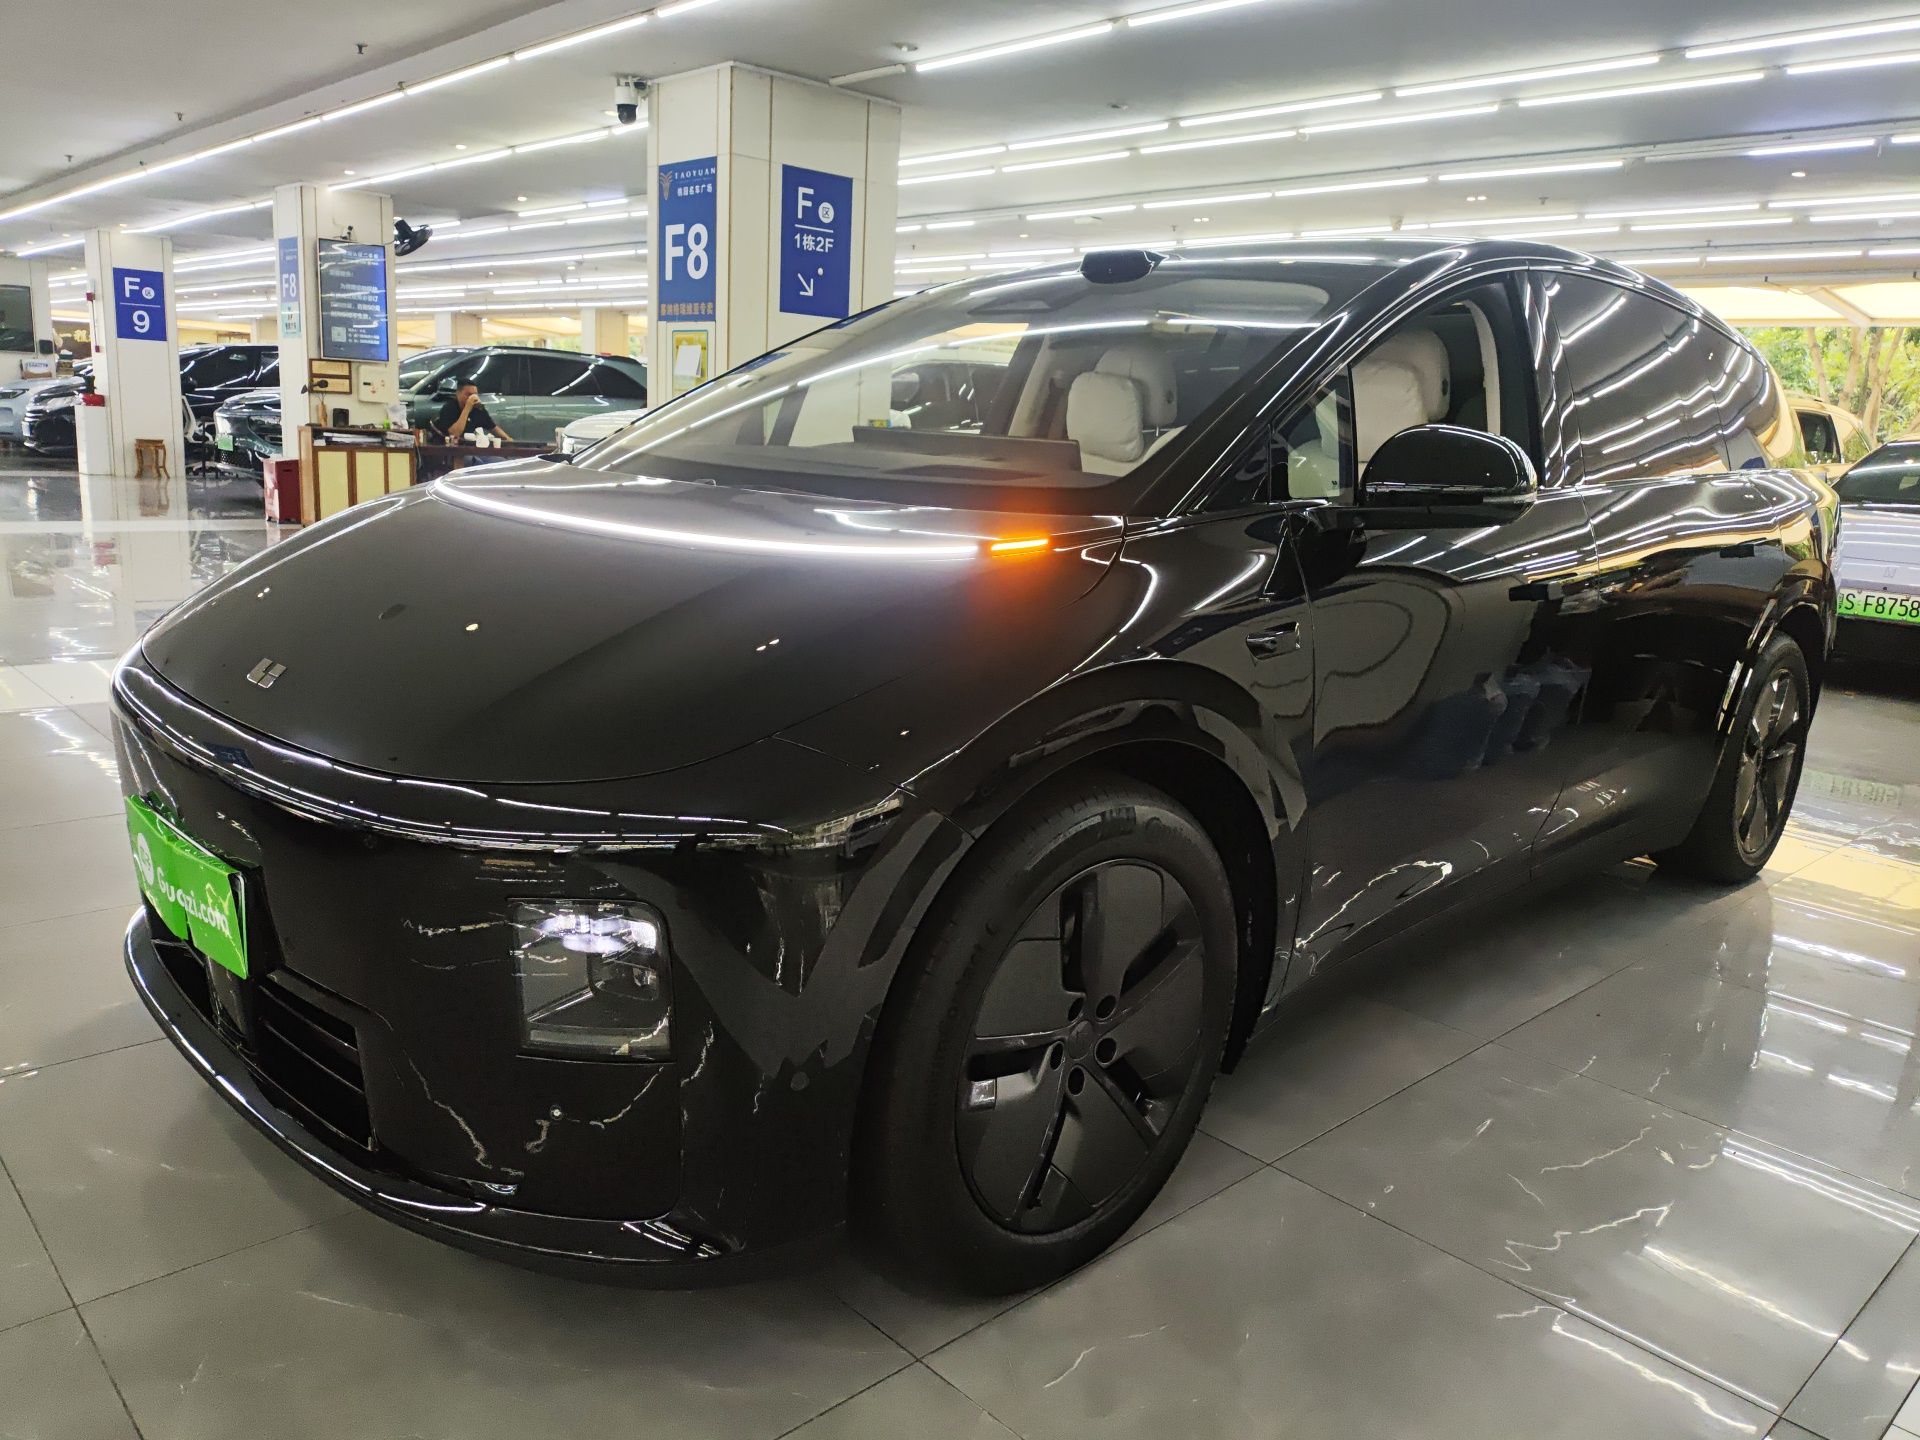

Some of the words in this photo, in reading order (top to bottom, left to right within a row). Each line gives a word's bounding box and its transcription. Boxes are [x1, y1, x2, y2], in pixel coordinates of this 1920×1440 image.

[675, 167, 716, 180] TAOYUAN
[664, 223, 709, 281] F8
[794, 233, 835, 253] 1栋2F
[282, 273, 297, 298] F8
[132, 310, 150, 333] 9
[157, 866, 231, 939] Guazi.com
